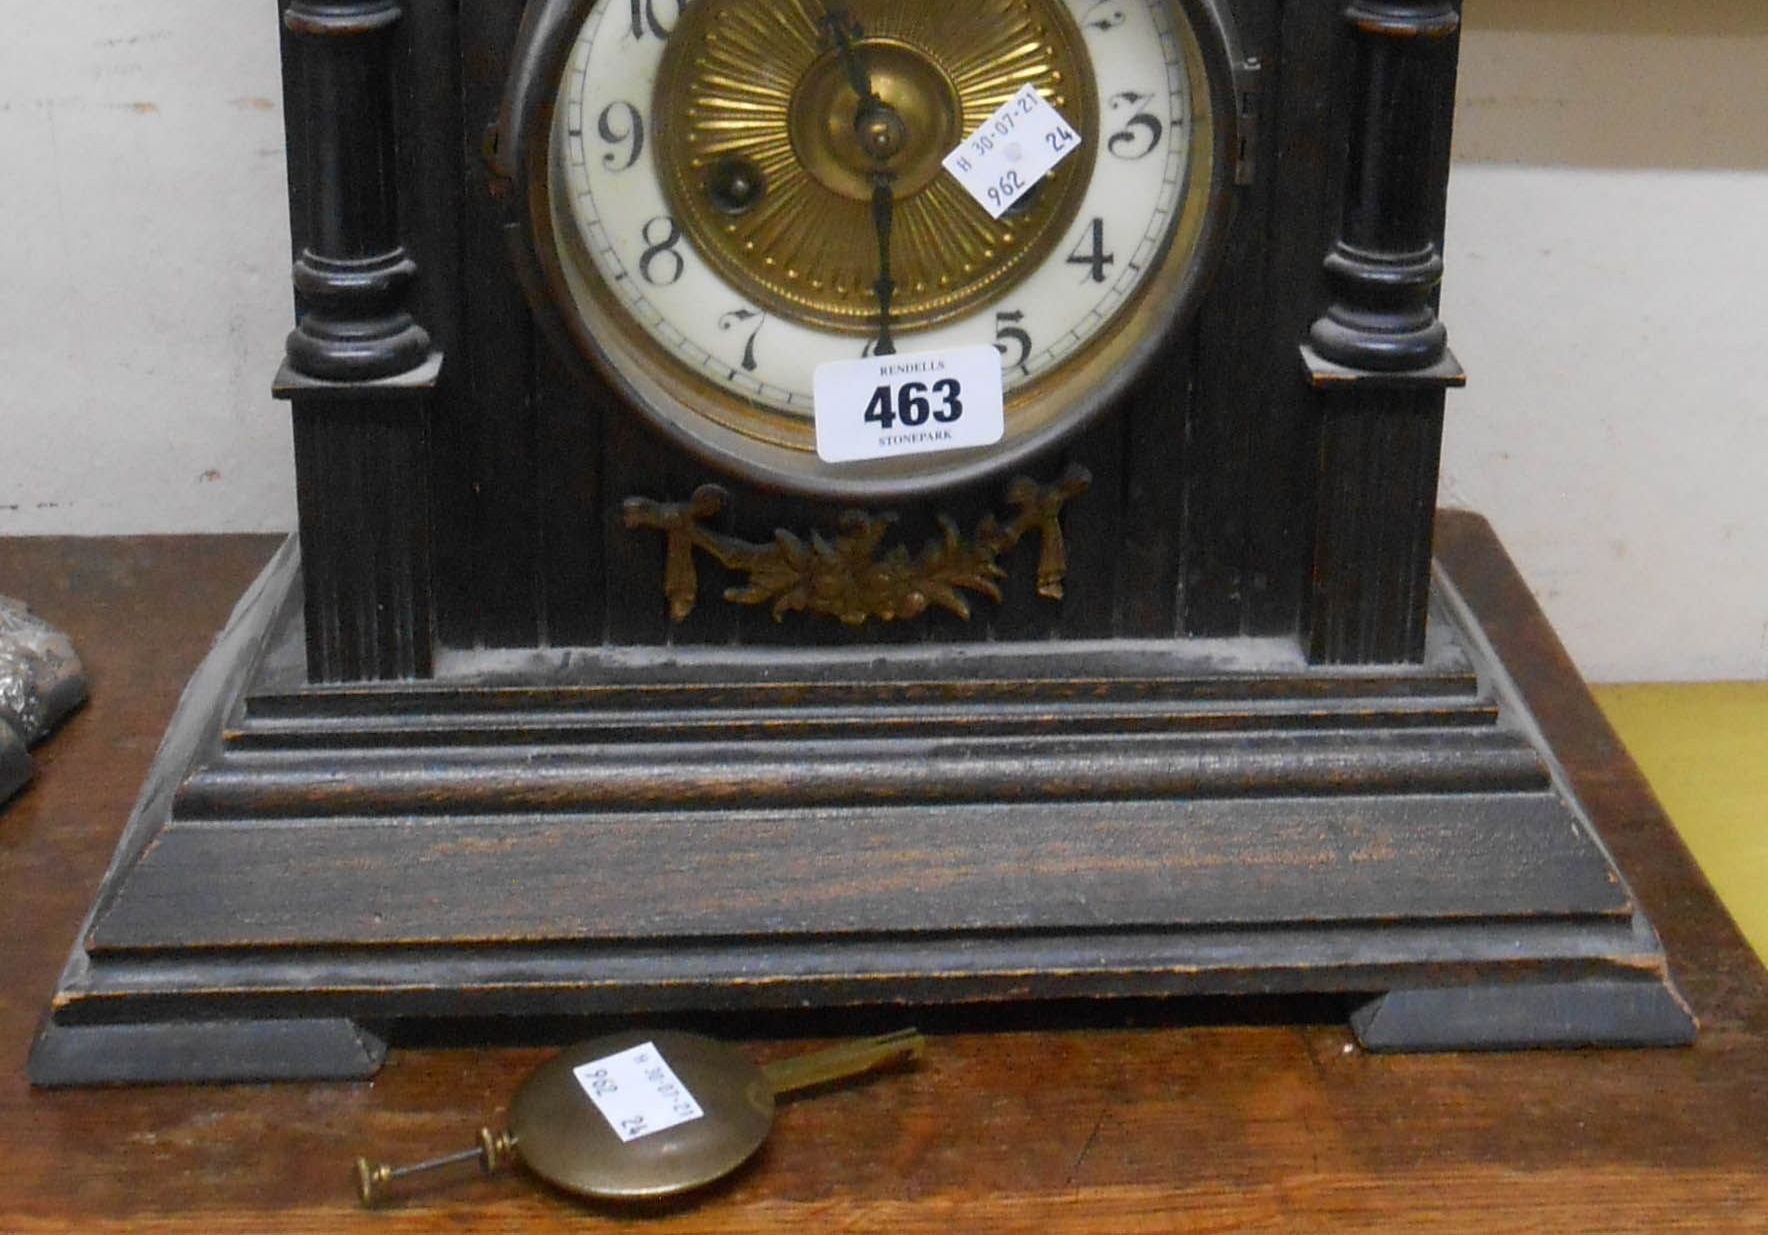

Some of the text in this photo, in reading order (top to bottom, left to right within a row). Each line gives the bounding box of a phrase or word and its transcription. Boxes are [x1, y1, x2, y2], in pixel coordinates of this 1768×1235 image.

[597, 100, 645, 172] 9
[1107, 91, 1163, 161] 3
[987, 126, 1074, 207] 962 24
[639, 216, 685, 287] 8
[1065, 217, 1115, 285] 4
[717, 309, 768, 372] 7
[879, 359, 945, 377] RENDELLS
[993, 309, 1033, 375] 5
[863, 377, 963, 430] 463
[878, 429, 952, 447] STONEPARK
